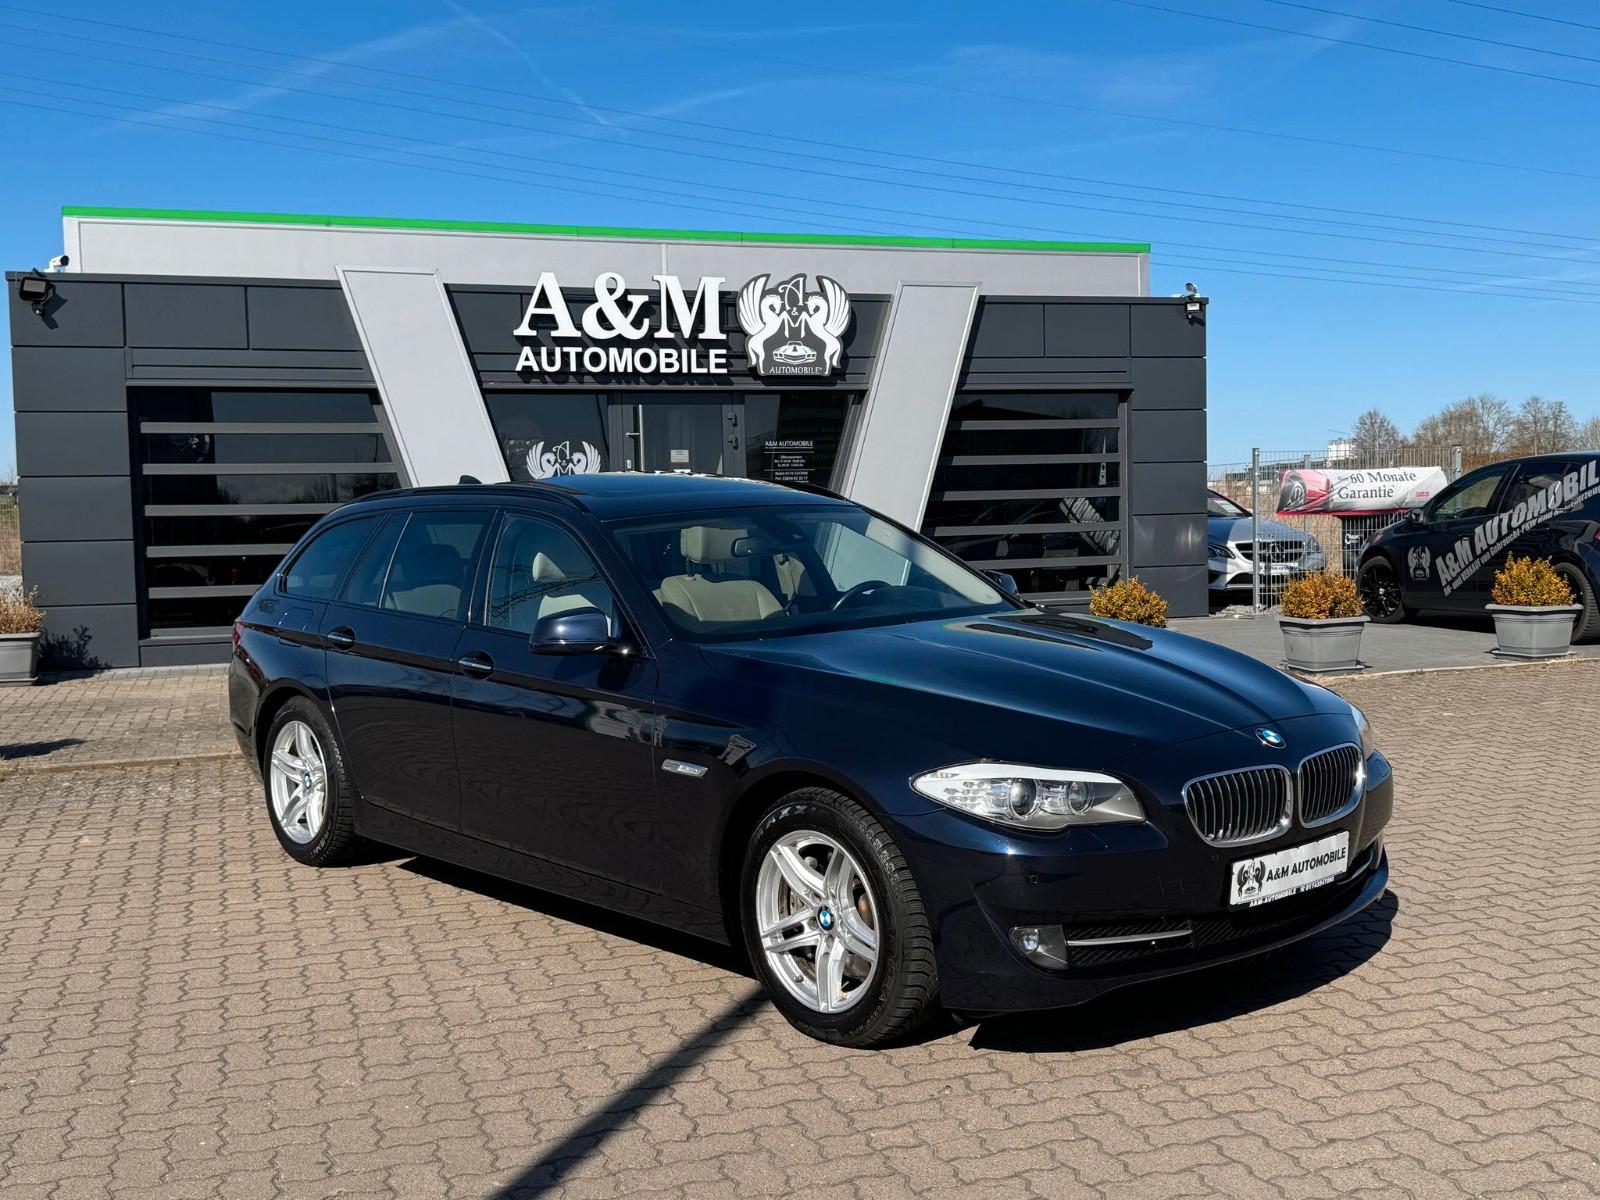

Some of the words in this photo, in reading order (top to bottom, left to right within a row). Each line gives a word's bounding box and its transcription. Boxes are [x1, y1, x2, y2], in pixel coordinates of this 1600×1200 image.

[512, 271, 728, 341] A&M
[514, 345, 728, 375] AUTOMOBILE
[769, 366, 820, 375] AUTOMOBILE
[1350, 473, 1364, 484] 60
[1368, 470, 1417, 484] Monate
[1435, 540, 1474, 587] A&M
[1266, 865, 1290, 883] A&M
[1291, 847, 1346, 876] AUTOMOBILE
